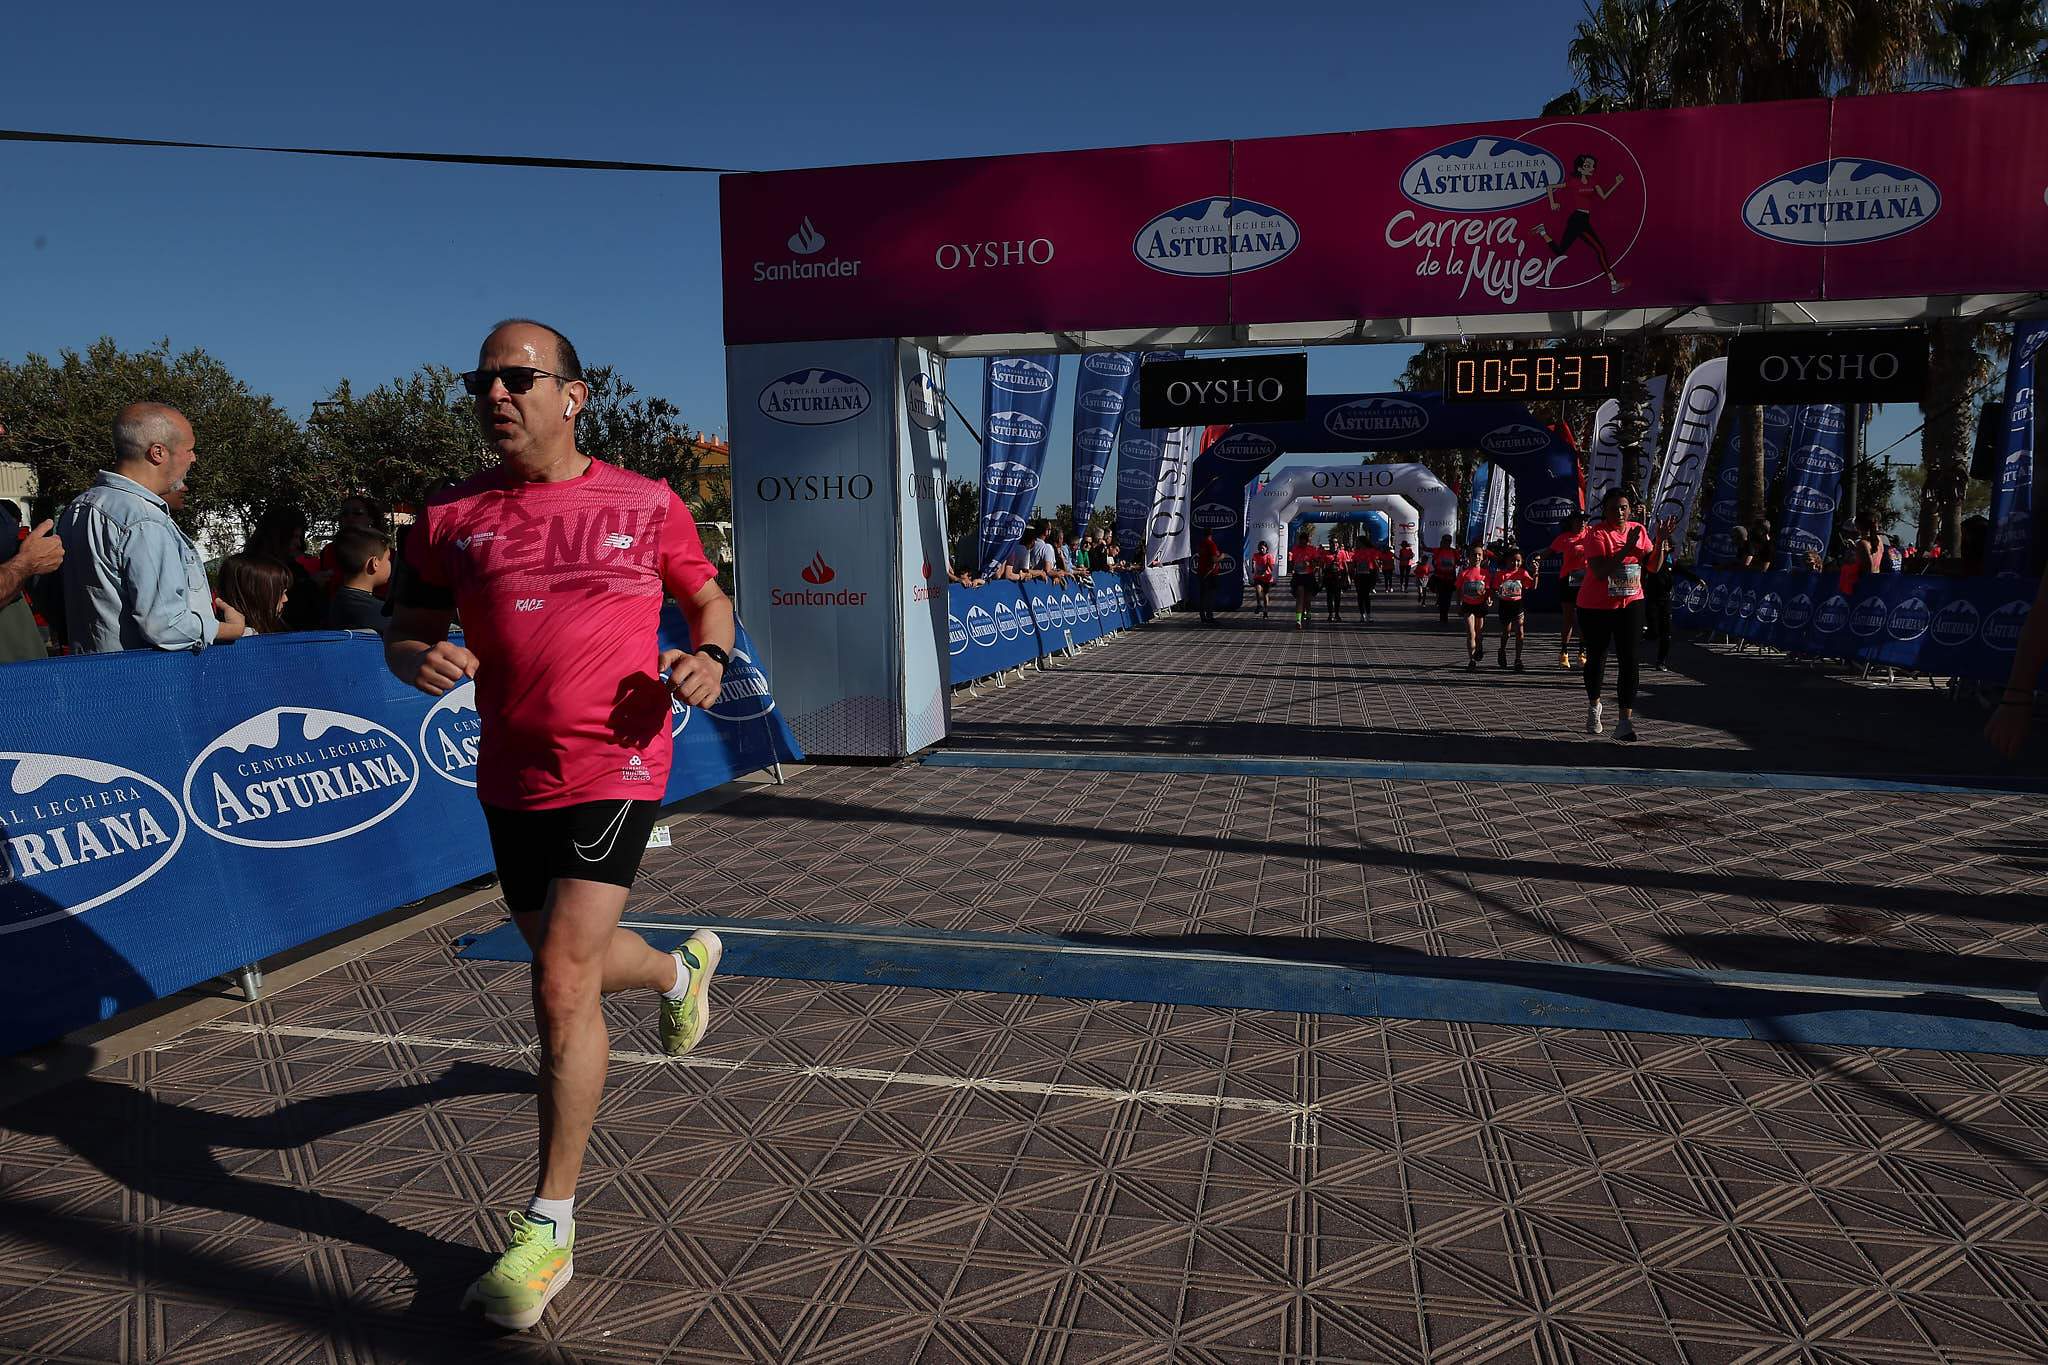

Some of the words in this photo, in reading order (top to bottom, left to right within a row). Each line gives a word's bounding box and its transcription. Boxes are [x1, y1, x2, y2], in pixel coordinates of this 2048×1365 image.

[1437, 162, 1488, 171] CENTRAL
[1494, 159, 1546, 169] LECHERA
[1412, 167, 1550, 194] ASTURIANA
[1788, 188, 1848, 199] CENTRAL
[1855, 184, 1919, 196] LECHERA
[1757, 194, 1924, 225] ASTURIANA
[1171, 224, 1222, 235] CENTRAL
[1228, 220, 1281, 231] ECHERA
[1385, 210, 1518, 249] Carrera
[935, 238, 1055, 271] OYSHO
[1146, 229, 1286, 259] ASTURIANA
[753, 258, 862, 283] Santander
[1416, 248, 1440, 276] de
[1446, 247, 1464, 275] la
[1458, 241, 1568, 304] Mujer
[991, 367, 1049, 388] ASTURIANA
[1456, 355, 1609, 394] 00:58:37
[1759, 352, 1899, 383] OYSHO
[766, 391, 863, 413] ASTURIANA
[1166, 377, 1283, 406] OYSHO
[1331, 412, 1421, 430] ASTURIANA
[757, 474, 873, 501] OYSHO
[908, 473, 945, 500] OYSHO
[1311, 470, 1394, 488] OYSHO
[515, 598, 545, 612] RACE
[771, 588, 867, 607] Santander
[238, 749, 314, 777] CENTRAL
[319, 736, 387, 761] LECHERA
[33, 786, 141, 820] LECHERA
[211, 753, 410, 829] ASTURIANA
